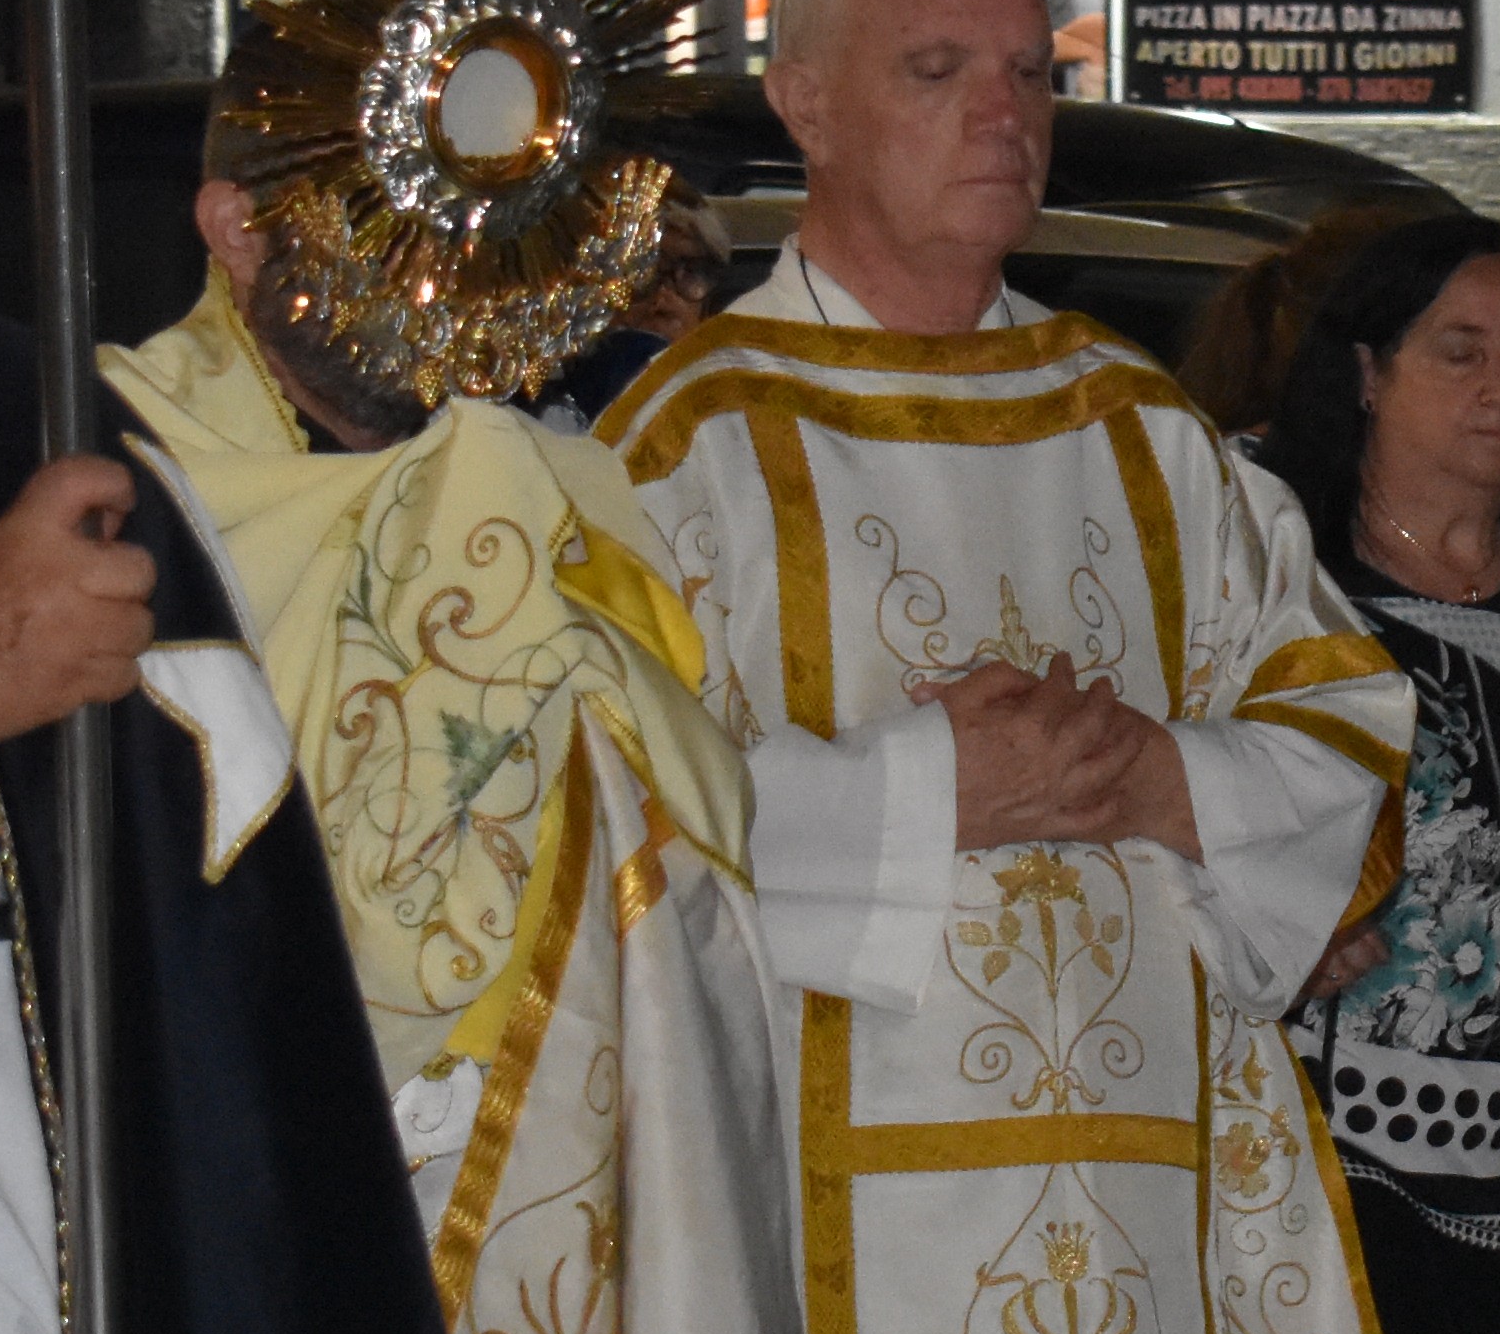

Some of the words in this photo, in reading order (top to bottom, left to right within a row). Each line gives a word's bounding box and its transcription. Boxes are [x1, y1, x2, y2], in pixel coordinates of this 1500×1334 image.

[1134, 5, 1209, 30] PIZZA
[1211, 5, 1241, 31] IN
[1244, 5, 1337, 32] PIAZZA
[1340, 5, 1377, 32] DA
[1134, 39, 1242, 71] APERTO
[1247, 39, 1327, 72] TUTTI
[1334, 40, 1348, 72] I
[1352, 40, 1458, 72] GIORNI
